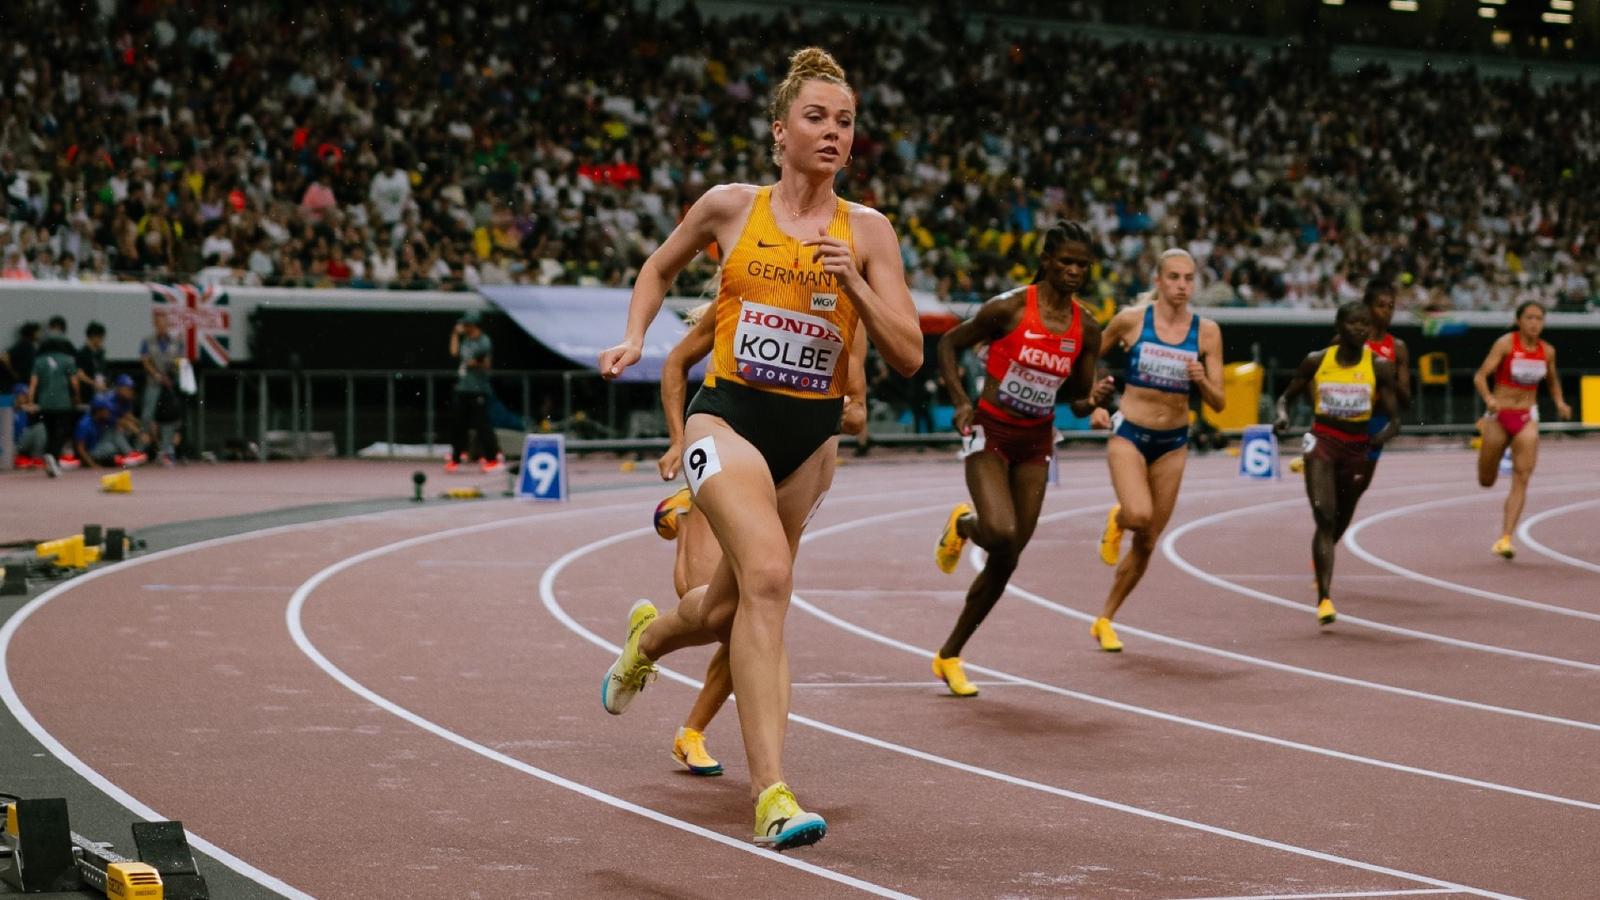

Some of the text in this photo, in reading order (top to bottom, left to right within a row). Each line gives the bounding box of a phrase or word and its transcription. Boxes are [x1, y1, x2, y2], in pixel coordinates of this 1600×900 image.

[747, 260, 839, 288] GERMAN
[812, 297, 837, 307] WGV
[741, 309, 843, 343] HONDA
[740, 333, 832, 371] KOLBE
[1018, 344, 1071, 373] KENYA
[1007, 380, 1054, 403] ODIRA
[689, 447, 708, 480] 9
[1245, 438, 1271, 475] 6
[527, 451, 557, 496] 9
